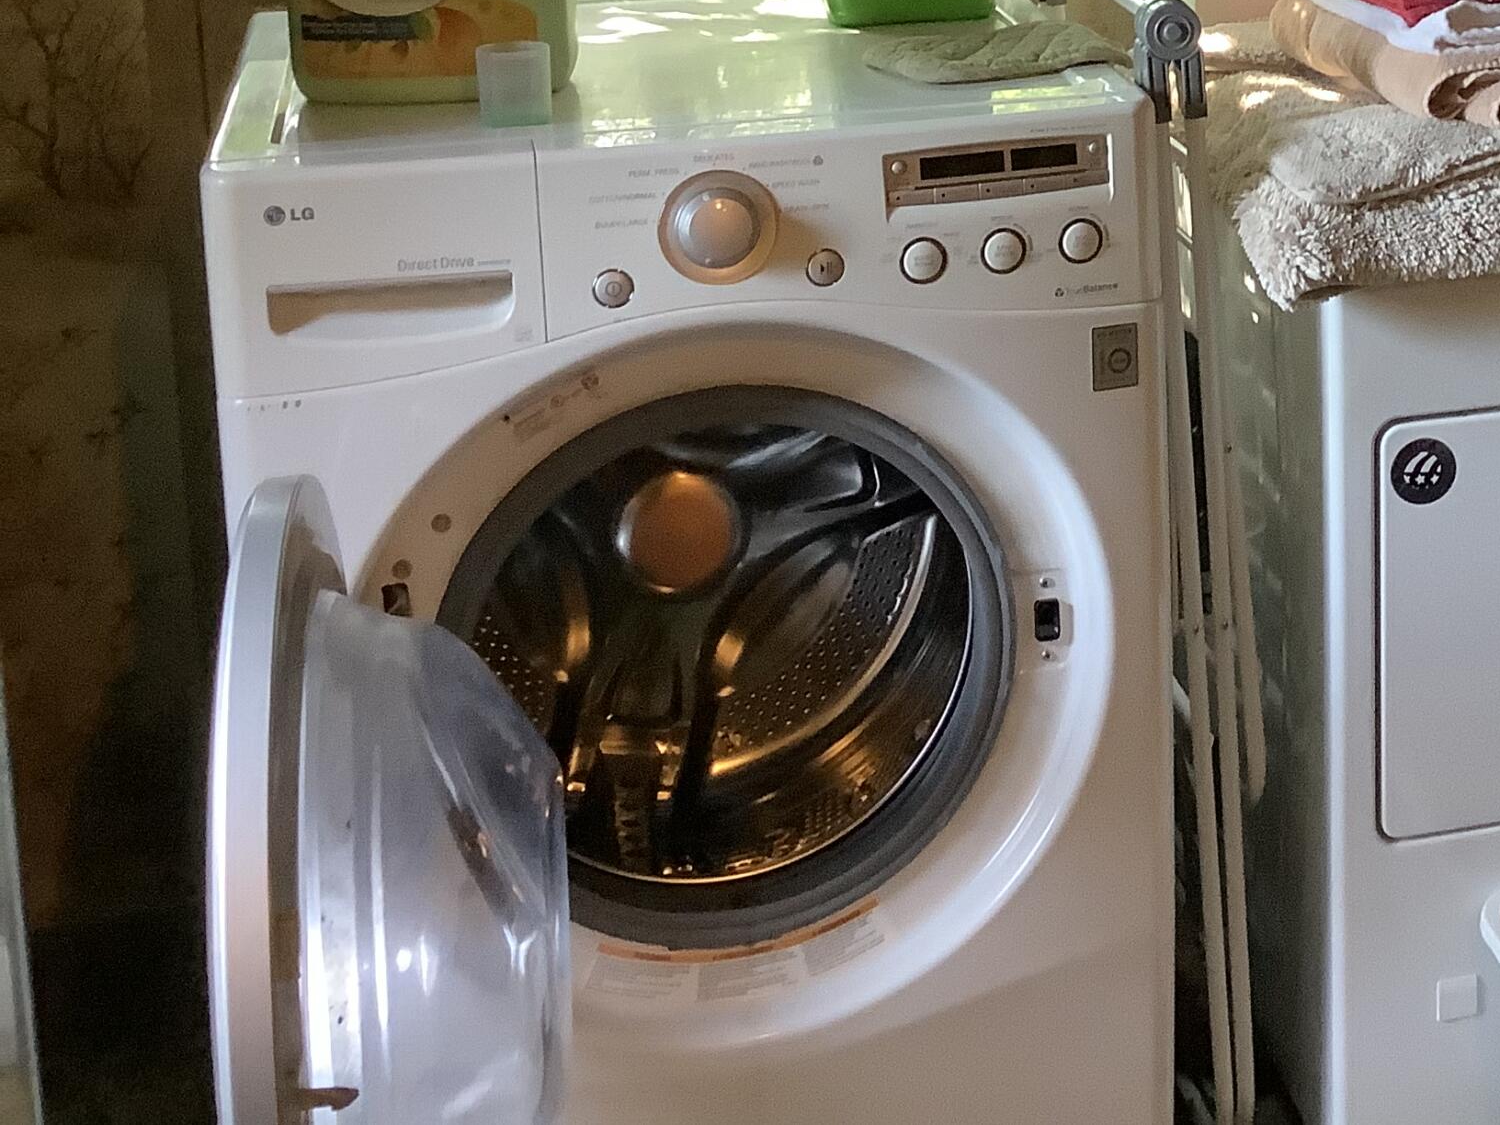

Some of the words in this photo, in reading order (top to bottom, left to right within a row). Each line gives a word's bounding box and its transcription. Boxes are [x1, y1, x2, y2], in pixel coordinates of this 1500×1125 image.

[290, 207, 314, 221] LG
[397, 257, 438, 272] Direct
[440, 256, 474, 269] Drive
